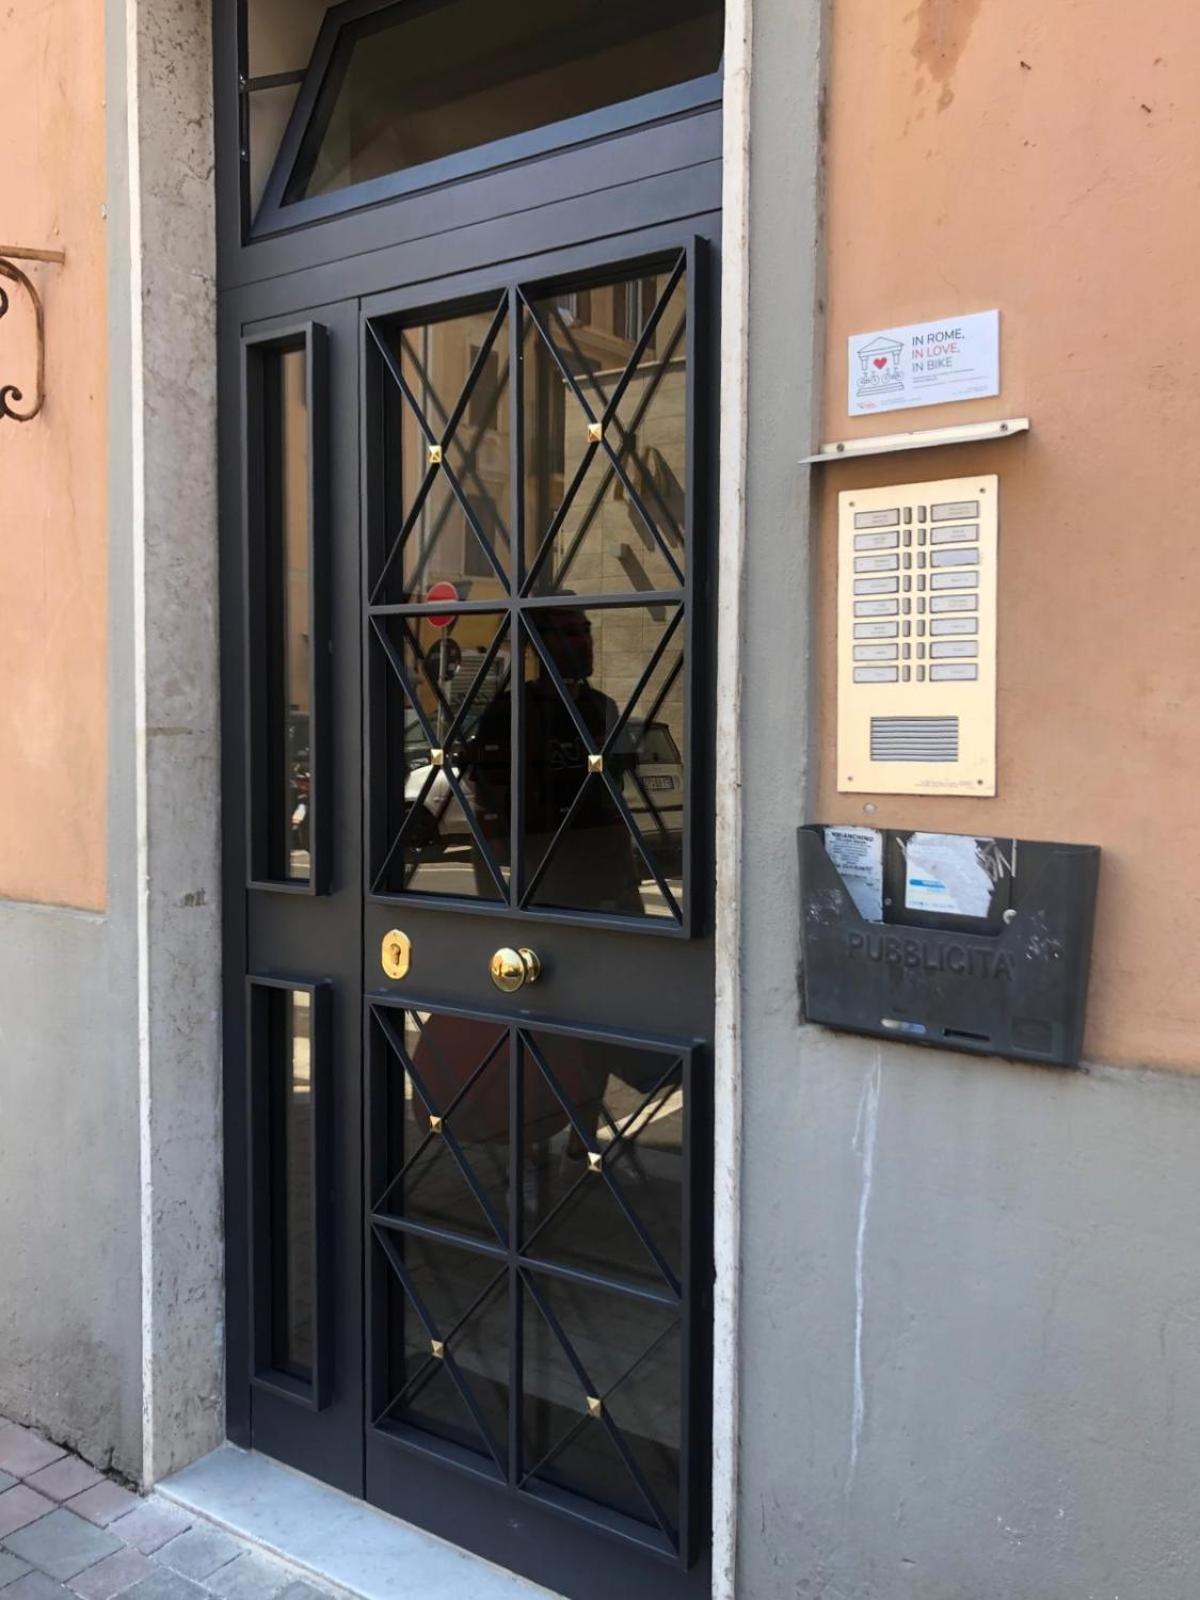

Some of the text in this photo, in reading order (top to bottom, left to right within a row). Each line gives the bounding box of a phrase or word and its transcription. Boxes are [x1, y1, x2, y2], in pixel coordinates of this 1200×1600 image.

[912, 335, 924, 346] IN
[912, 348, 924, 360] IN
[912, 356, 953, 373] IN BIKE
